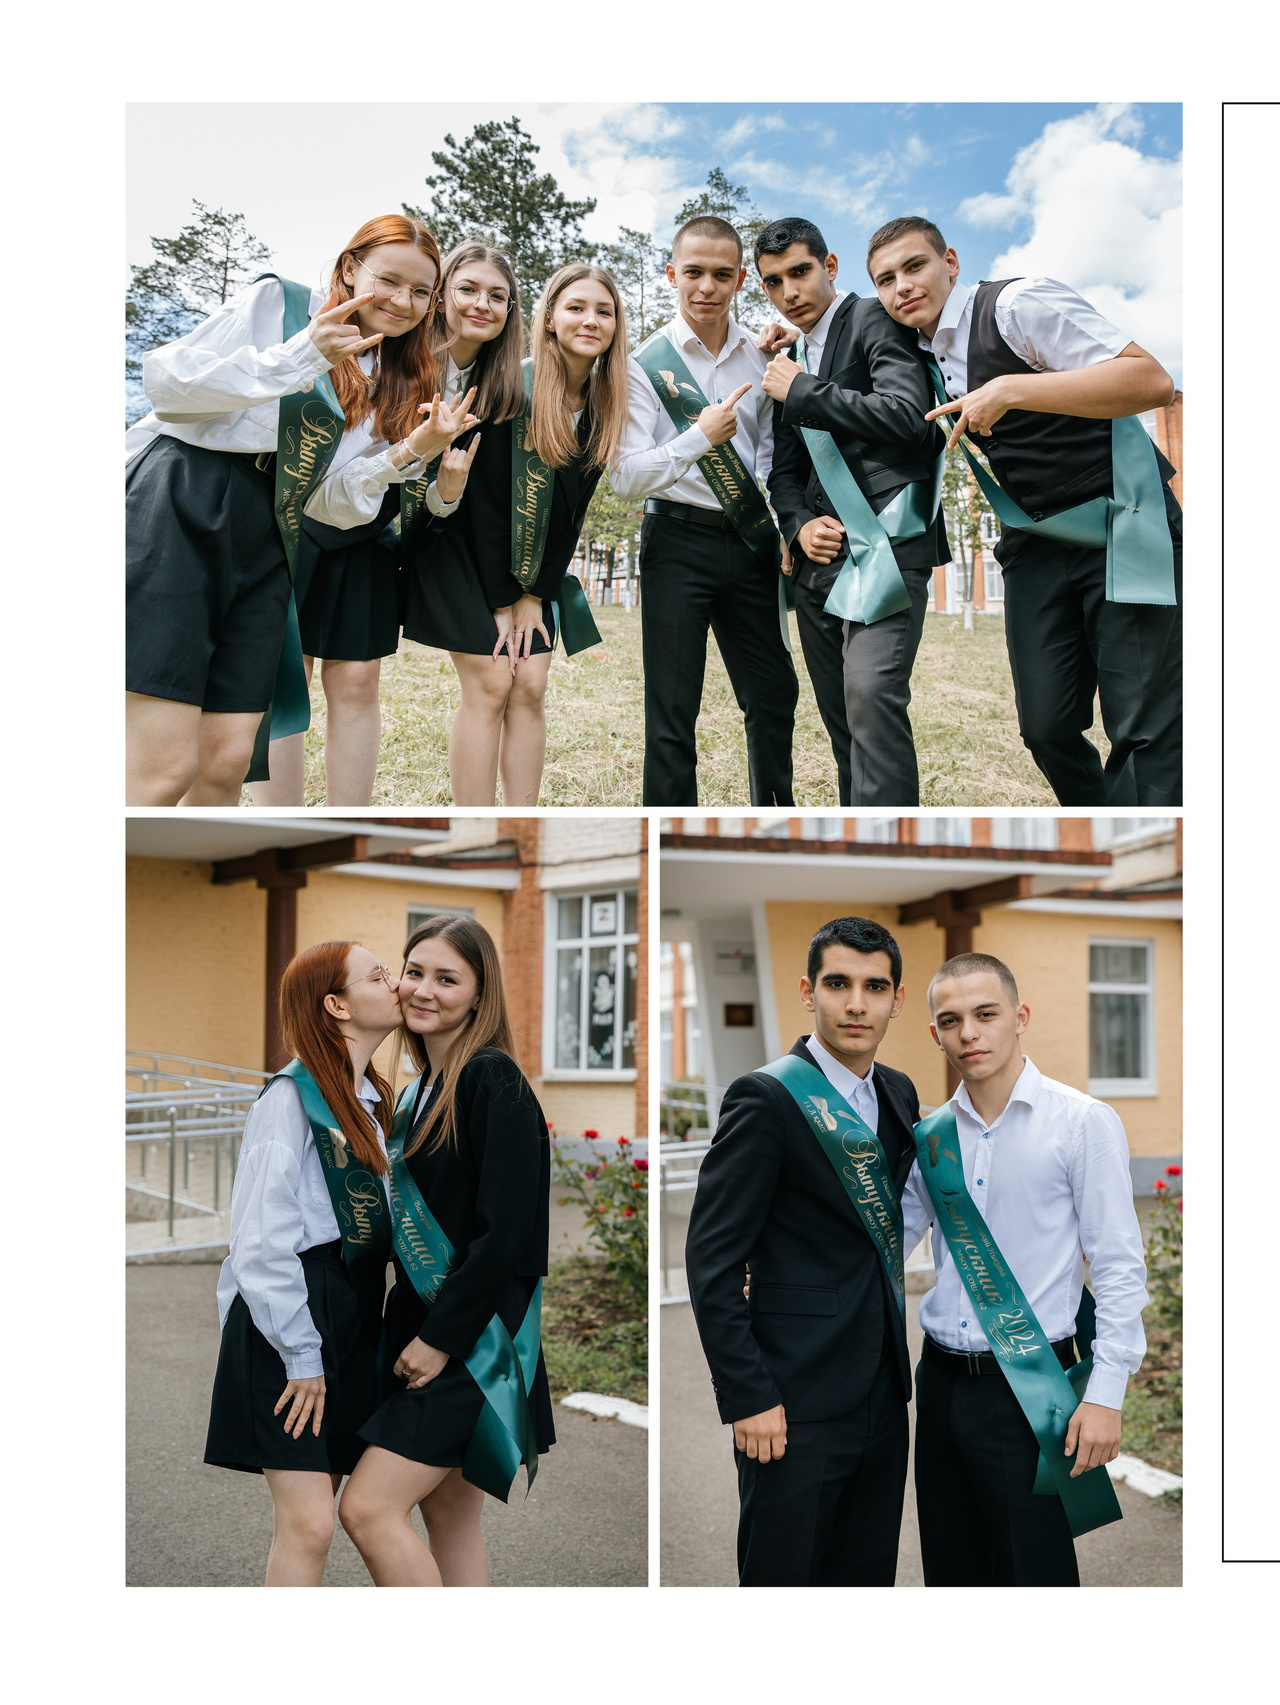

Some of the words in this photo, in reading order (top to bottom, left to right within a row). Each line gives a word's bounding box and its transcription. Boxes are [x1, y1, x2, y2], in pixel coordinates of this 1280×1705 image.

[841, 1129, 898, 1254] Выпускник
[863, 1208, 878, 1231] МБОУ
[875, 1231, 887, 1248] СОШ
[936, 1168, 1004, 1306] Выпускник
[410, 1261, 419, 1272] 62
[955, 1248, 971, 1273] МБОУ
[965, 1273, 980, 1294] СОШ
[979, 1301, 988, 1311] 62
[998, 1308, 1042, 1357] 2024
